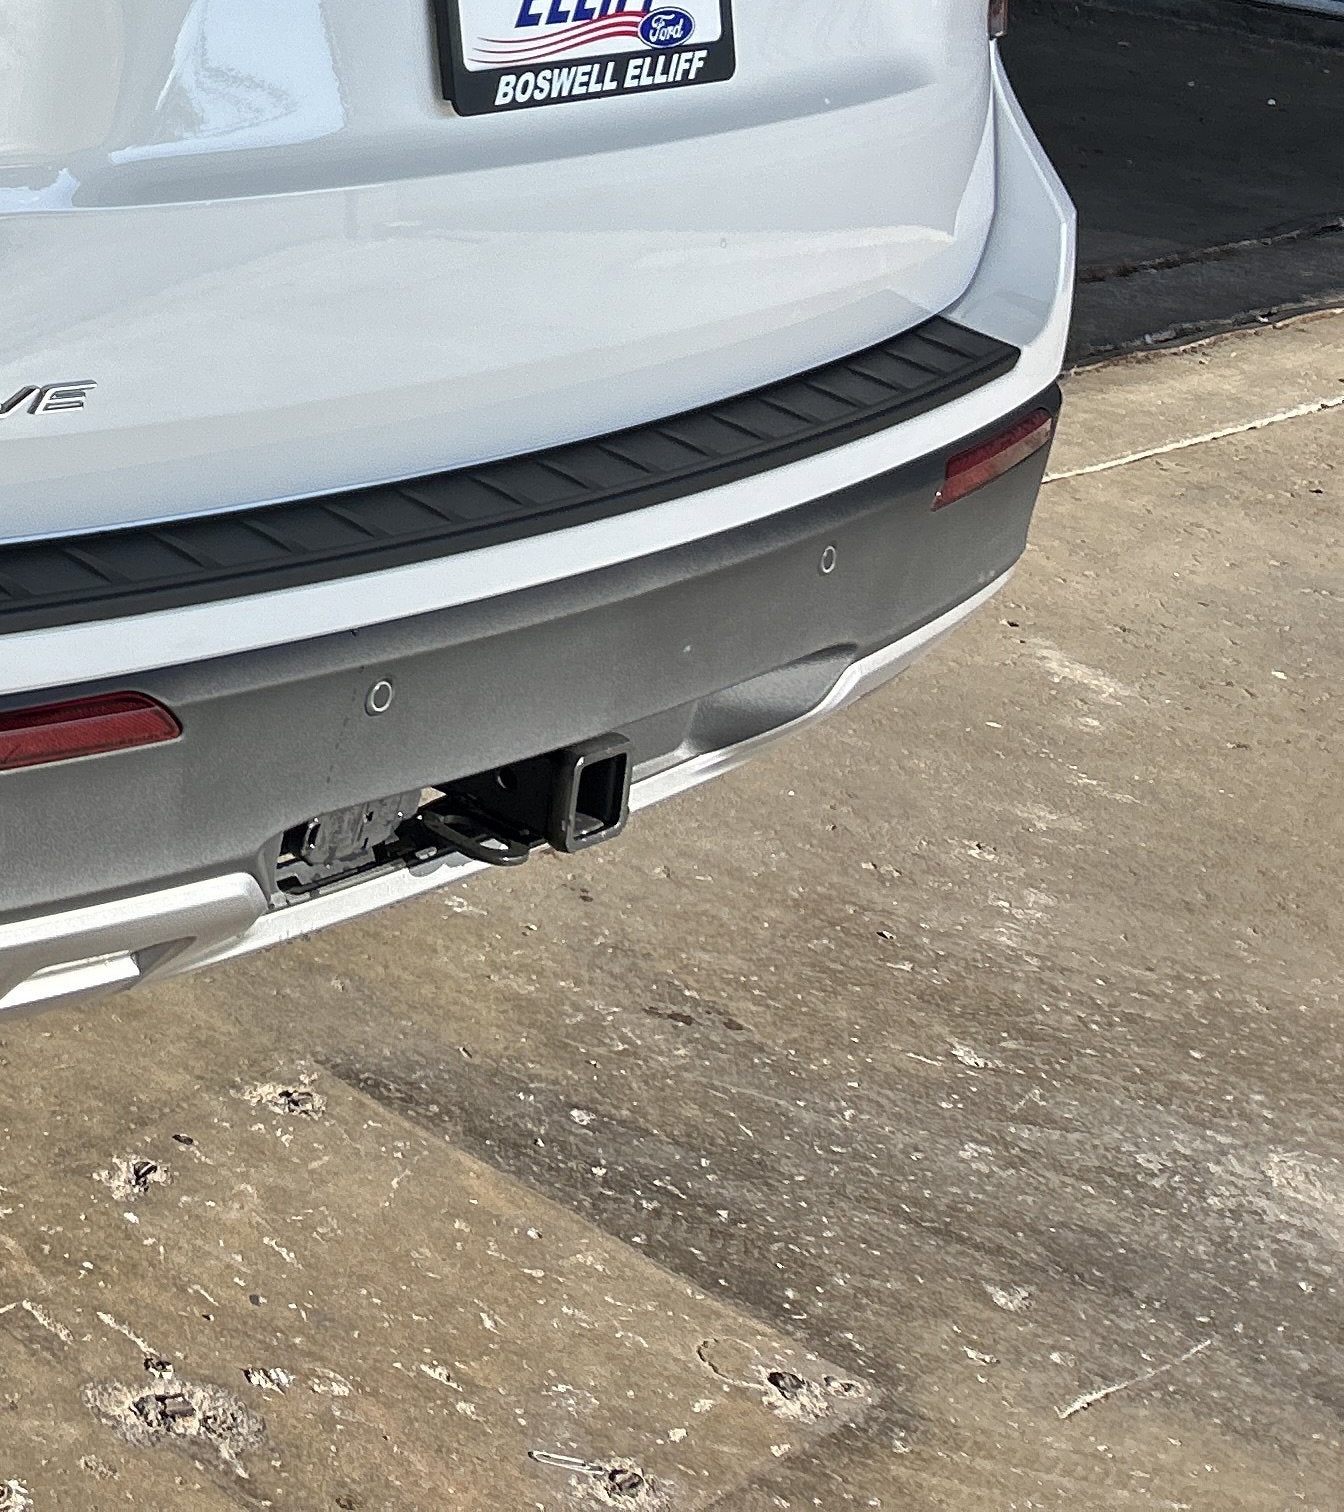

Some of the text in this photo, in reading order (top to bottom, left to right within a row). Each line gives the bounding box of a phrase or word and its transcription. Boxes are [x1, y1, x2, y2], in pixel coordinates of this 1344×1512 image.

[649, 14, 685, 43] Ford
[494, 50, 707, 106] BOSWELL ELLIFF
